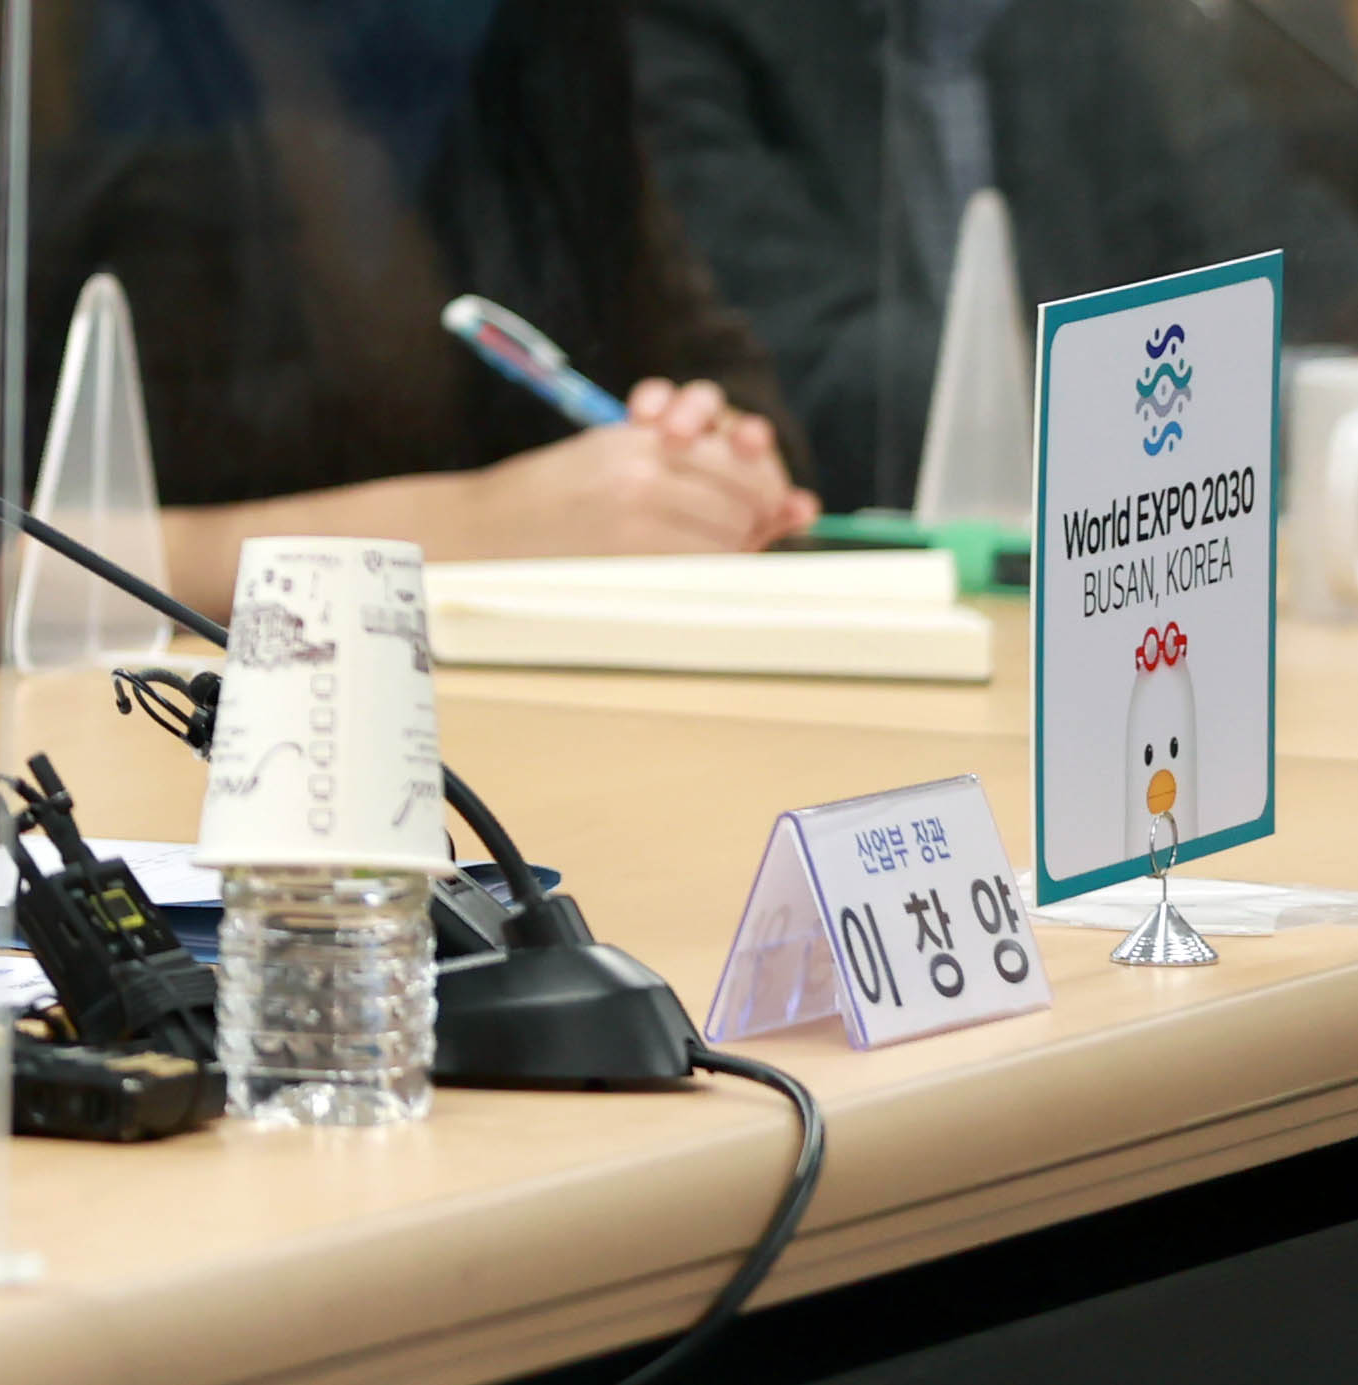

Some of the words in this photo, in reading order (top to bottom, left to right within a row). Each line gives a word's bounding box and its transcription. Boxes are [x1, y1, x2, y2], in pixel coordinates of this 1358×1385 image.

[1063, 495, 1131, 561] World
[1137, 481, 1197, 542] EXPO
[1201, 466, 1255, 525] 2030
[1083, 555, 1160, 618] BUSAN,
[1165, 535, 1233, 596] KOREA
[853, 824, 909, 874] 산업부
[910, 816, 952, 864] 장관
